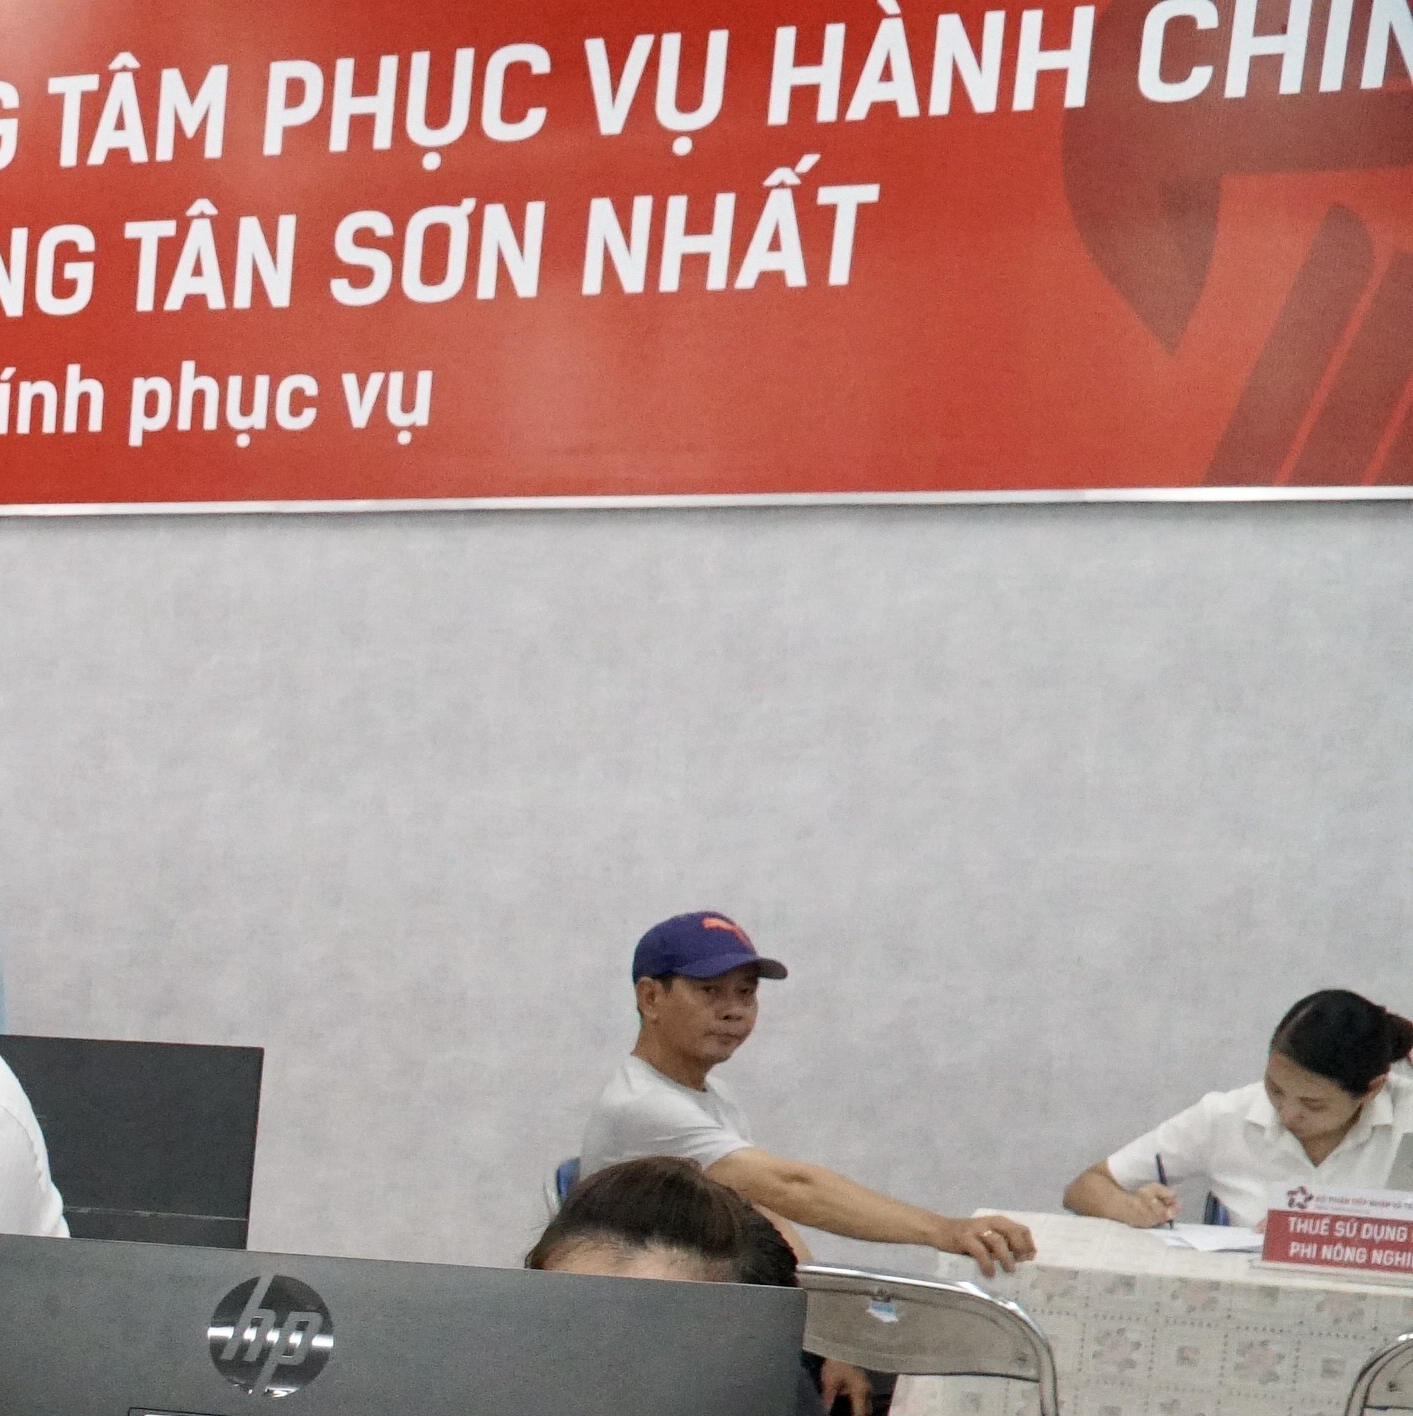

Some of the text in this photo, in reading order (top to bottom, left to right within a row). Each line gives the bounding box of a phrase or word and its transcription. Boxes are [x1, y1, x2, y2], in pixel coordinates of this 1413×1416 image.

[48, 52, 228, 167] TÂM
[263, 44, 550, 170] PHỤC
[585, 30, 728, 155] VỤ
[768, 0, 1095, 125] HÀNH
[125, 199, 296, 311] TÂN
[330, 198, 545, 306] SƠN
[582, 154, 880, 295] NHẤT
[129, 371, 318, 447] phục
[342, 371, 432, 444] vụ
[1289, 1241, 1413, 1268] PHI NÔNG NGHI
[1361, 1223, 1408, 1244] DỤNG
